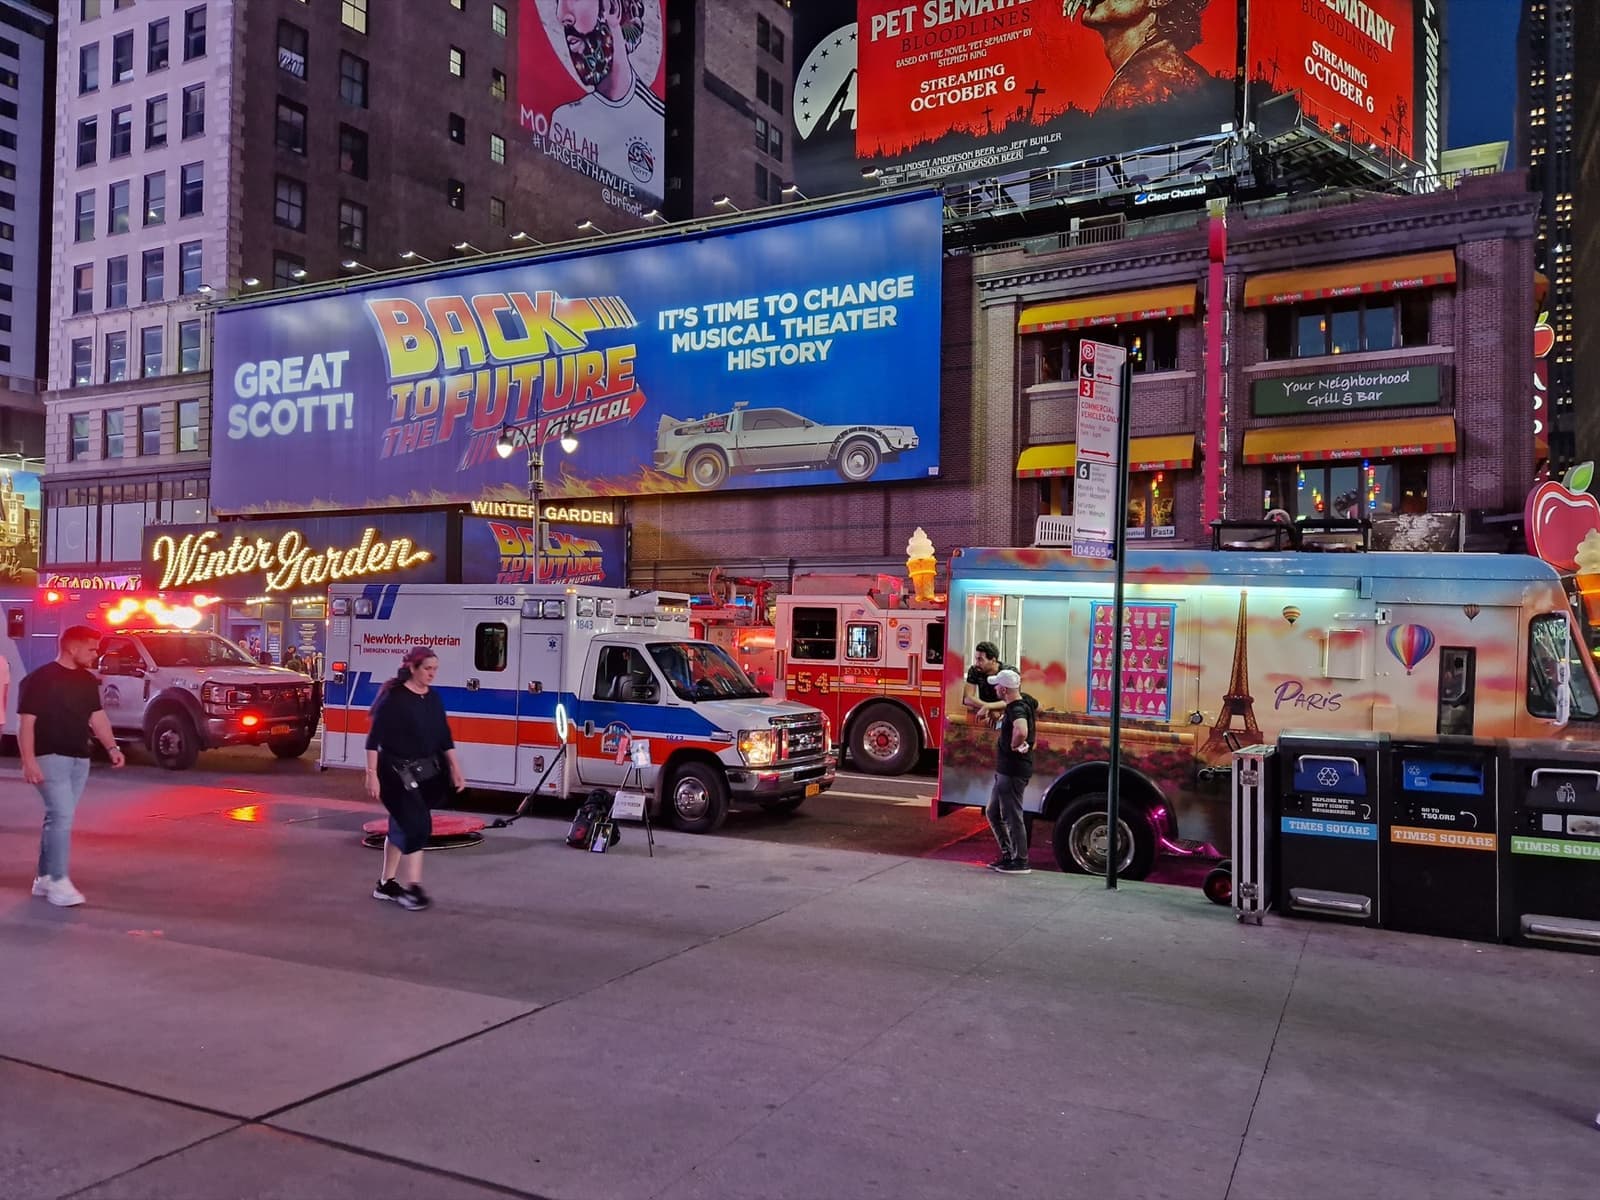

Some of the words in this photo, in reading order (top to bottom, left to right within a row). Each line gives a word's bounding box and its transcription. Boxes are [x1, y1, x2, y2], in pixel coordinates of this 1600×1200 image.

[871, 6, 917, 42] PET
[901, 7, 1031, 53] BLOODLINES
[896, 55, 918, 68] BASED
[918, 53, 929, 62] ON
[930, 50, 943, 60] THE
[944, 44, 967, 58] NOVEL
[1022, 28, 1033, 37] BY
[937, 53, 968, 68] STEPHEN
[969, 49, 987, 59] KING
[919, 63, 1005, 94] STREAMING
[1312, 40, 1368, 89] STREAMING
[910, 80, 998, 113] OCTOBER
[1003, 75, 1016, 92] 6
[1304, 56, 1364, 108] OCTOBER
[1366, 95, 1375, 113] 6
[520, 103, 548, 136] MO
[553, 122, 599, 162] SALAH
[532, 133, 636, 198] #LARGERTHANLIFE
[900, 159, 931, 173] LINDSEY
[932, 150, 973, 167] ANDERSON
[974, 146, 996, 157] BEER
[1008, 139, 1028, 152] JEFF
[1029, 132, 1062, 147] BUHLER
[925, 165, 956, 179] LINDSEY
[957, 156, 1000, 172] ANDERSON
[1001, 150, 1022, 162] BEER
[1147, 192, 1171, 202] Clear
[1170, 185, 1207, 199] Channel
[703, 298, 759, 324] TIME
[763, 292, 798, 317] TO
[803, 275, 915, 308] CHANGE
[366, 291, 637, 379] BACK
[671, 321, 776, 353] MUSICAL
[780, 305, 897, 340] THEATER
[727, 339, 833, 371] HISTORY
[234, 351, 350, 400] GREAT
[1083, 380, 1091, 397] 3
[1282, 381, 1315, 397] Your
[1318, 370, 1410, 391] Neighborhood
[388, 378, 439, 424] TO
[437, 343, 639, 443] FUTURE
[1306, 392, 1340, 407] Grill
[1356, 391, 1383, 402] Bar
[227, 392, 354, 440] SCOTT!
[1081, 401, 1115, 415] COMMERCIAL
[1081, 410, 1106, 422] VEHICLES
[380, 417, 437, 460] THE
[1079, 462, 1088, 479] 6
[544, 506, 614, 525] GARDEN
[1152, 528, 1174, 536] Pasta
[153, 530, 274, 589] Winter
[265, 528, 432, 592] Garden
[500, 557, 523, 572] TO
[568, 574, 600, 585] MUSICAL
[493, 596, 516, 606] 1843
[576, 620, 593, 630] 1843
[363, 633, 461, 648] NewYork-Presbyterian
[798, 671, 830, 694] 54
[1288, 820, 1323, 834] TIMES
[1326, 821, 1371, 836] SQUARE
[1421, 812, 1456, 821] TSQ.ORG
[1393, 830, 1437, 845] TIMES
[1439, 833, 1494, 848] SQUARE
[1514, 840, 1560, 853] TIMES
